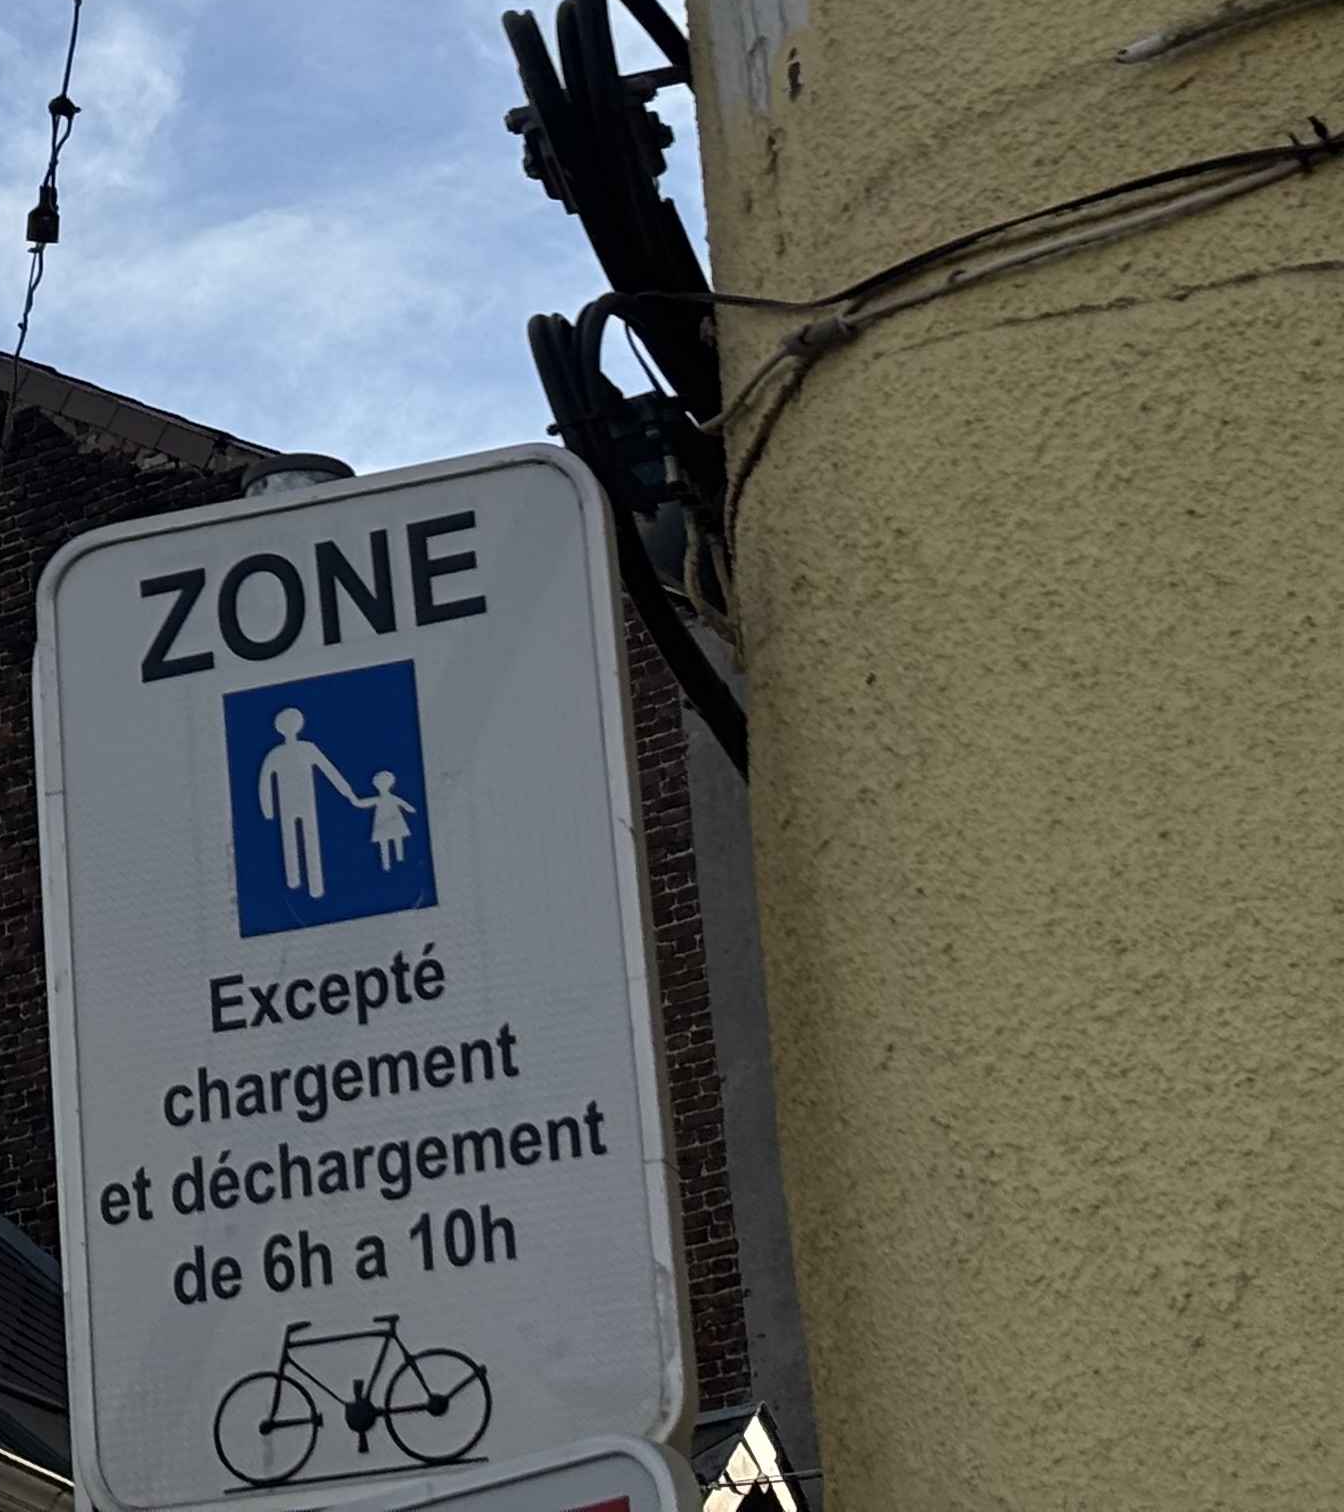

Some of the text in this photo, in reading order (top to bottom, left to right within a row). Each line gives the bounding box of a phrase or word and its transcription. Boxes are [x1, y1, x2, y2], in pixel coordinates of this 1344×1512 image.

[139, 509, 488, 684] ZONE
[209, 941, 446, 1034] Excepté
[163, 1023, 520, 1128] chargement
[100, 1100, 608, 1226] et déchargement
[173, 1202, 518, 1306] de 6h a 10h
